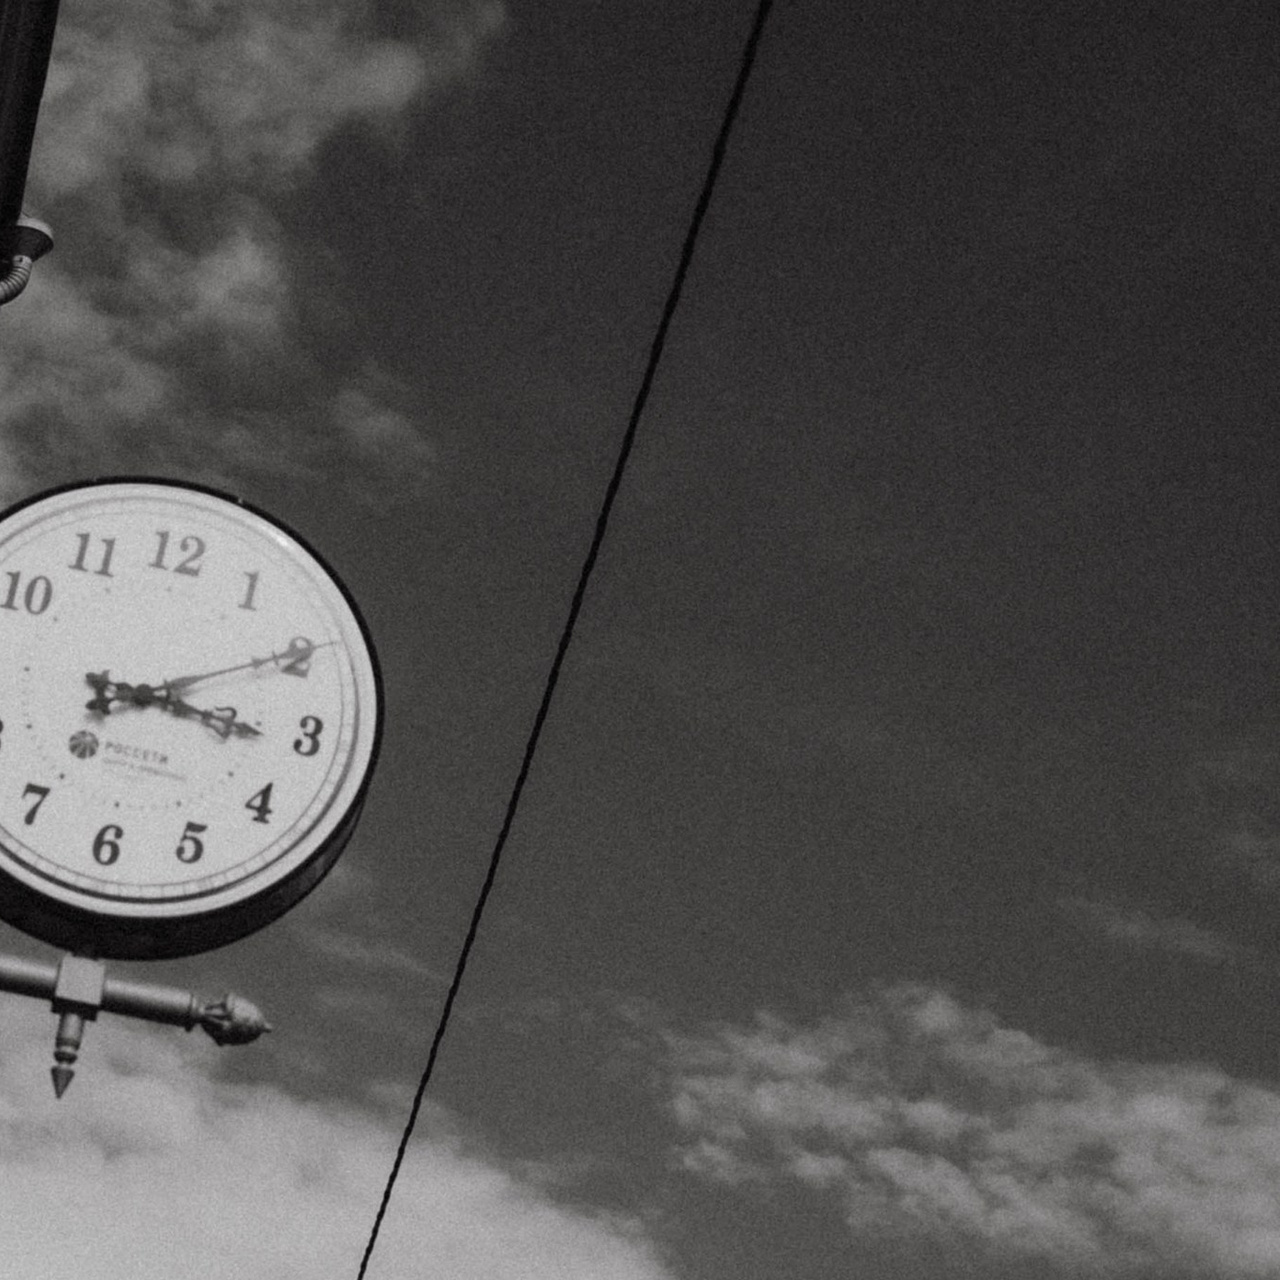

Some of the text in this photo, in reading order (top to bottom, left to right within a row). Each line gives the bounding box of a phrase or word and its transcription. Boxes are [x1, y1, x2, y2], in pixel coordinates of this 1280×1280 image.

[68, 532, 117, 578] 11
[148, 529, 207, 577] 12
[237, 570, 261, 612] 1
[280, 635, 315, 679] 2
[292, 715, 324, 757] 3
[21, 783, 51, 826] 7
[244, 782, 275, 824] 4
[92, 824, 124, 866] 6
[175, 821, 208, 864] 5
